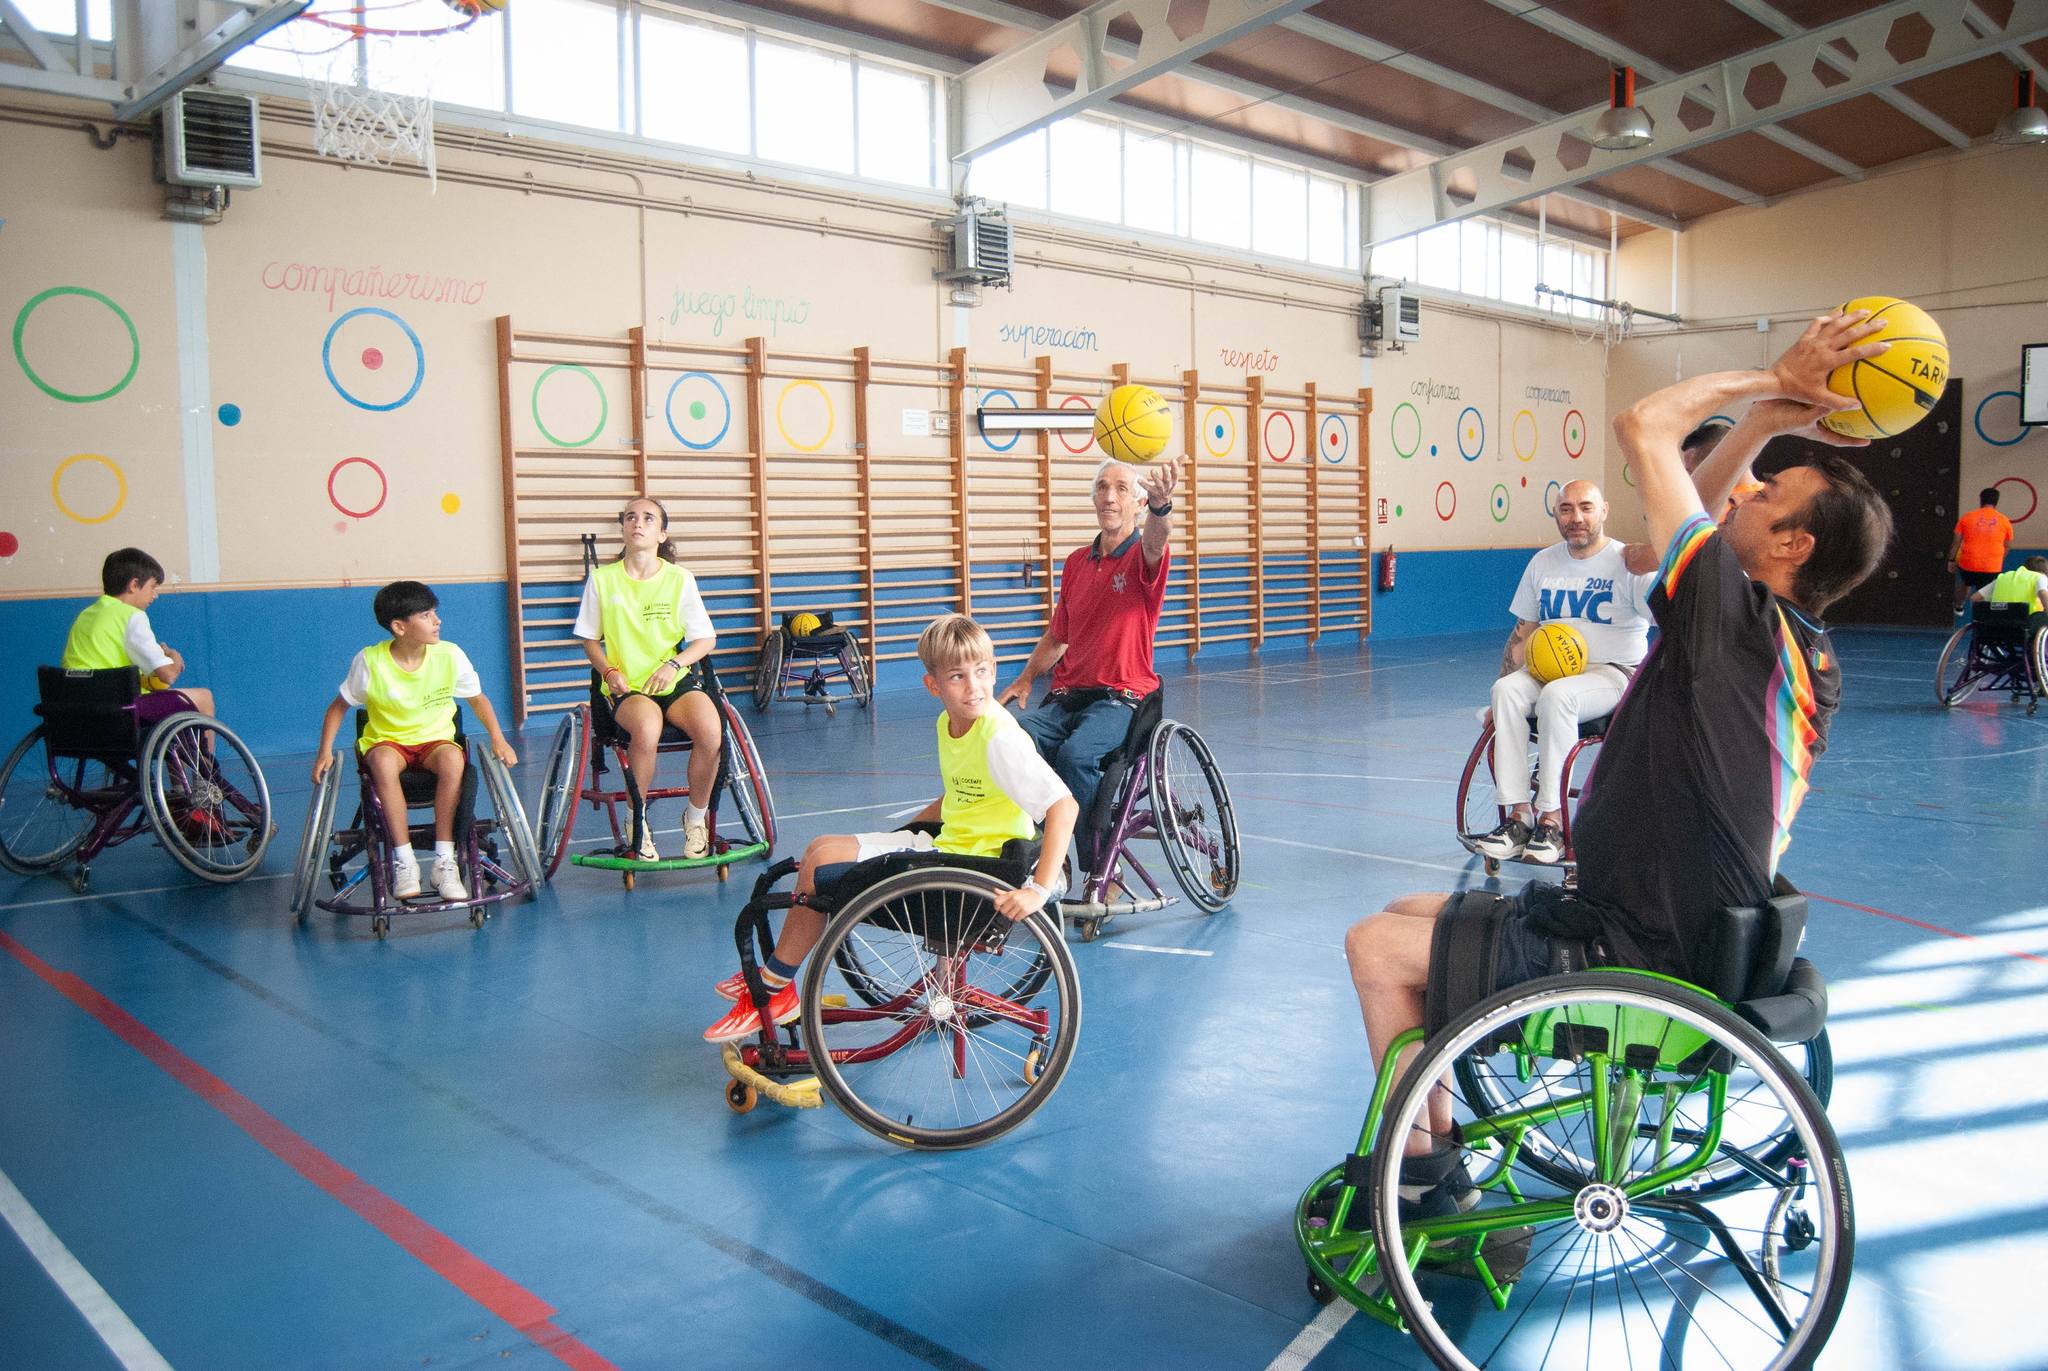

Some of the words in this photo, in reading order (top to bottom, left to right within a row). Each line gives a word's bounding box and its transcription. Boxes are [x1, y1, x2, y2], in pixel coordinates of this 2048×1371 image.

[262, 261, 487, 312] compañerismo
[670, 288, 736, 337] juego
[742, 285, 811, 337] limpio
[1000, 323, 1099, 358] superación
[1220, 347, 1279, 376] respeto
[1411, 377, 1461, 404] confianza
[1585, 577, 1614, 591] 2014
[1540, 588, 1613, 625] NYC
[1556, 634, 1578, 672] TARMAK
